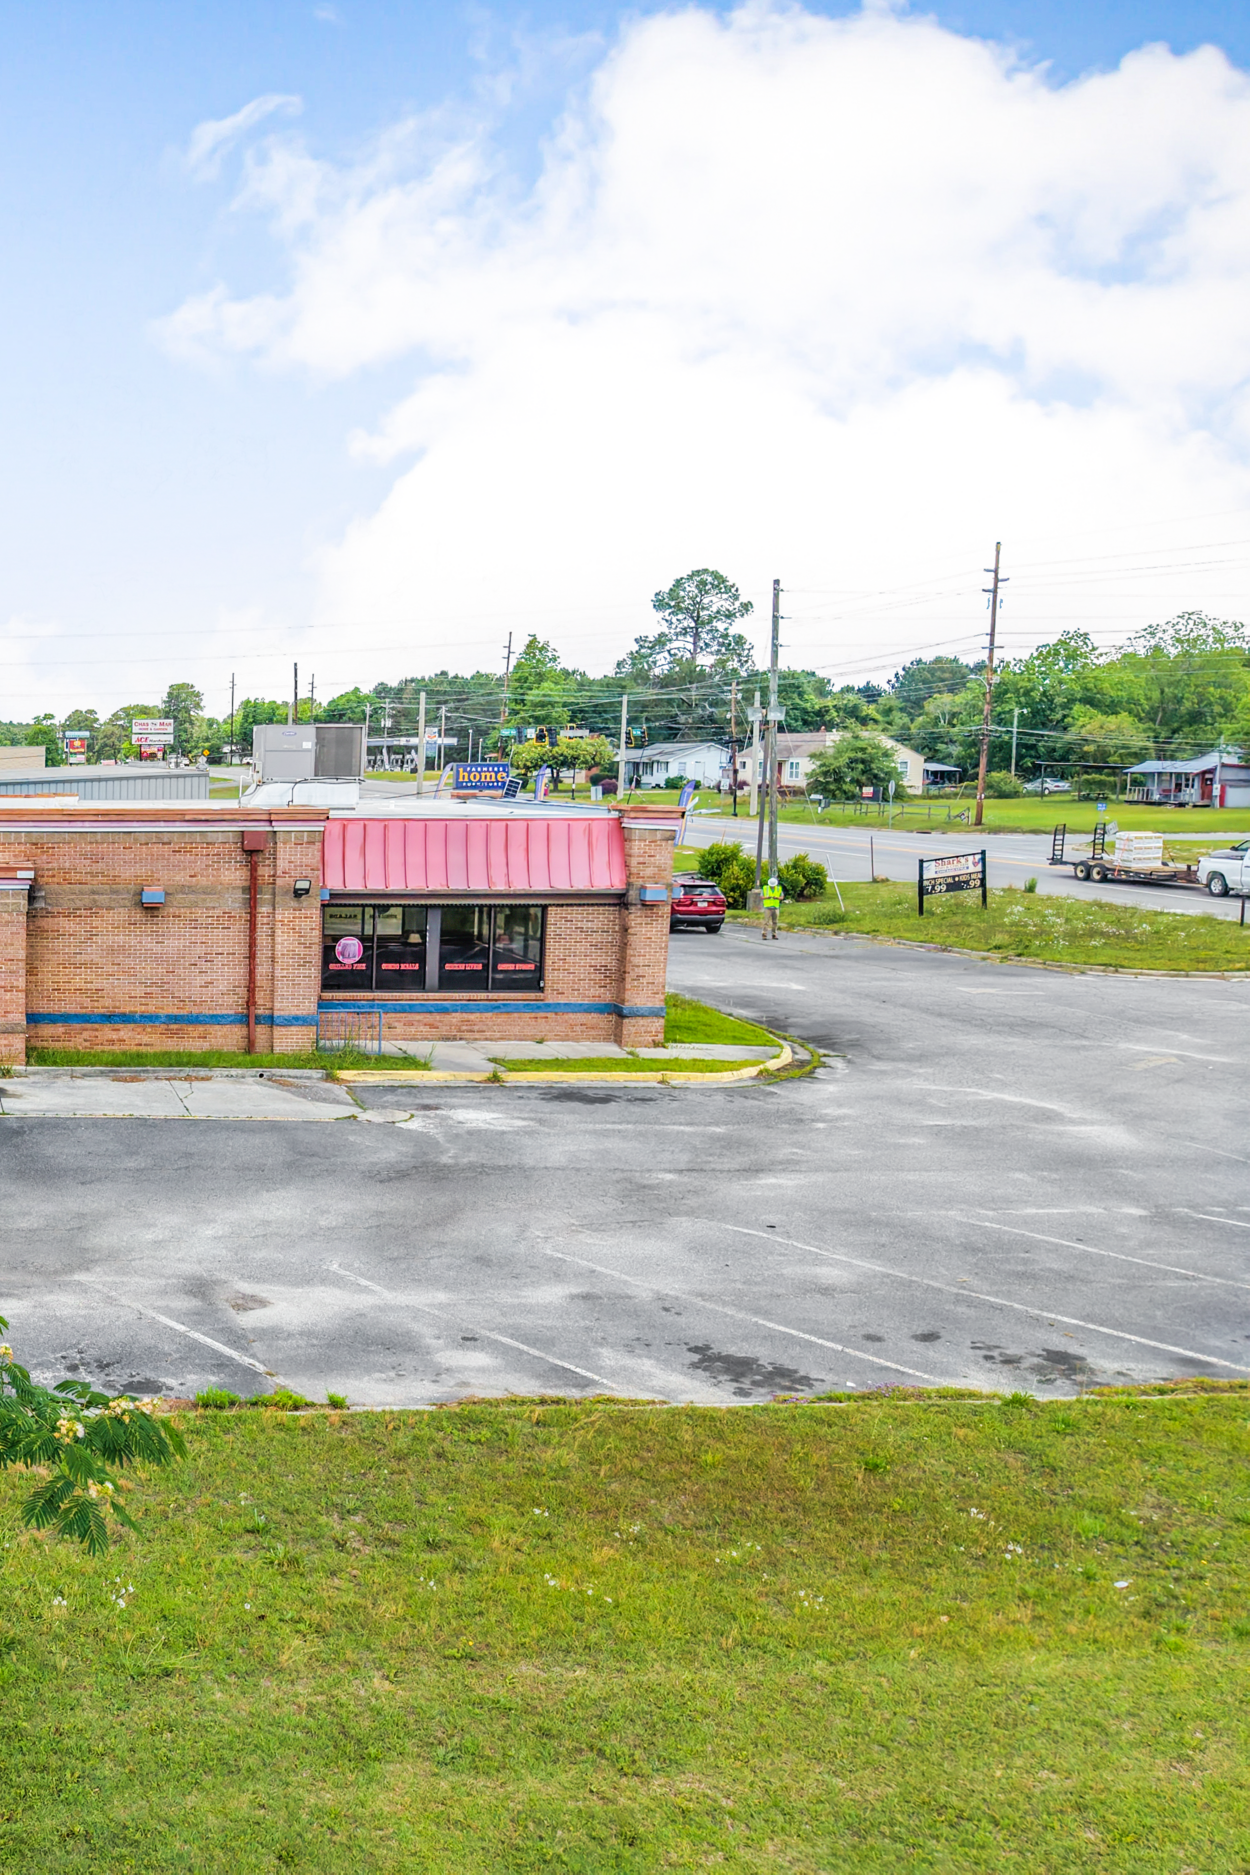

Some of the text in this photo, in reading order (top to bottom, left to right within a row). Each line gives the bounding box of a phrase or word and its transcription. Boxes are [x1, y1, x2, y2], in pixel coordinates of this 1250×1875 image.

[458, 767, 507, 782] home
[934, 856, 969, 867] Shark's
[936, 876, 953, 884] SPECIAL
[959, 873, 970, 881] KIDS
